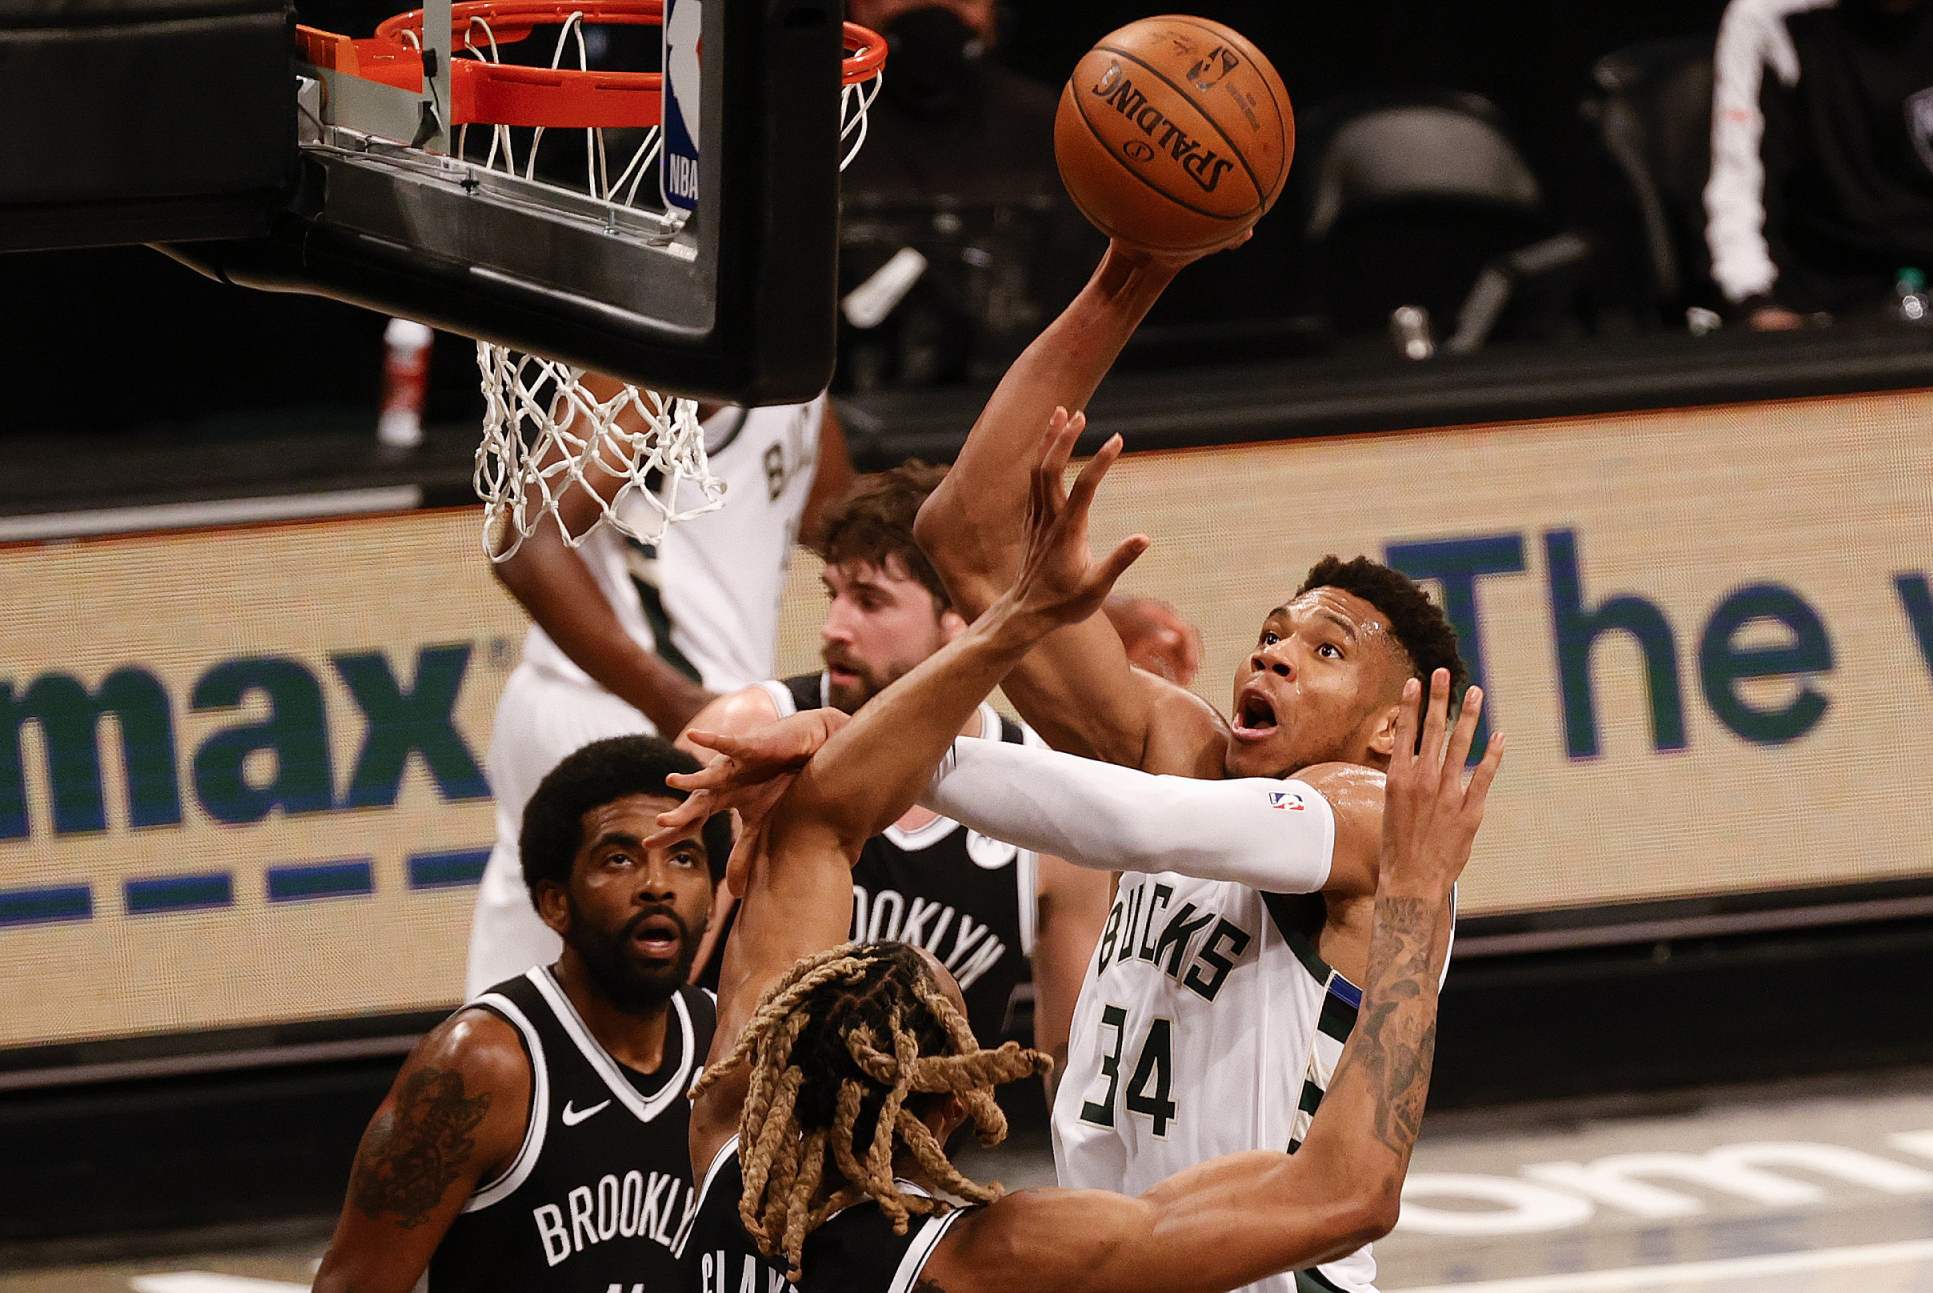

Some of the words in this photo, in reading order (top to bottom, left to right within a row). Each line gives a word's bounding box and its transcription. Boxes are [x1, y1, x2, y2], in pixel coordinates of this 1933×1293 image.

[669, 152, 699, 201] NBA
[1091, 58, 1235, 193] SPALDING
[1384, 528, 1834, 767] The
[1097, 881, 1252, 1004] BUCKS
[1078, 1003, 1178, 1140] 34
